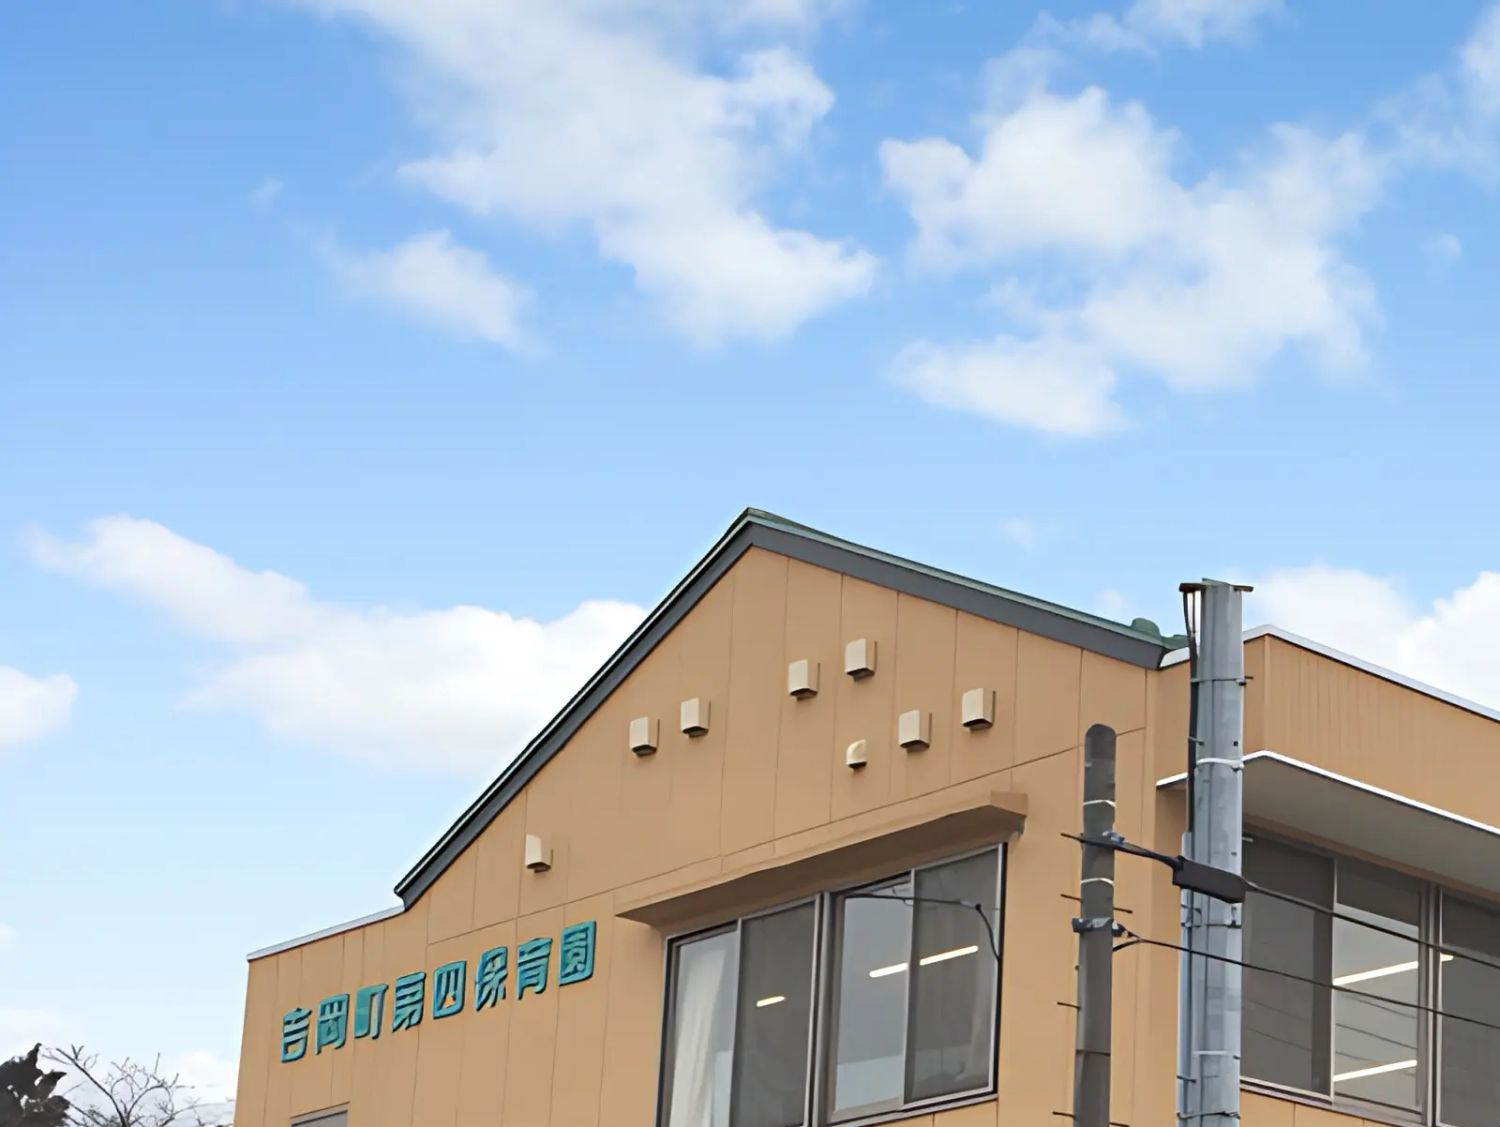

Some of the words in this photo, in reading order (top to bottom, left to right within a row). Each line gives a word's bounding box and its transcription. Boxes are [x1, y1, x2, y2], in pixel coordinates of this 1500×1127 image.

[281, 920, 597, 1063] 吉岡町第四保育園
